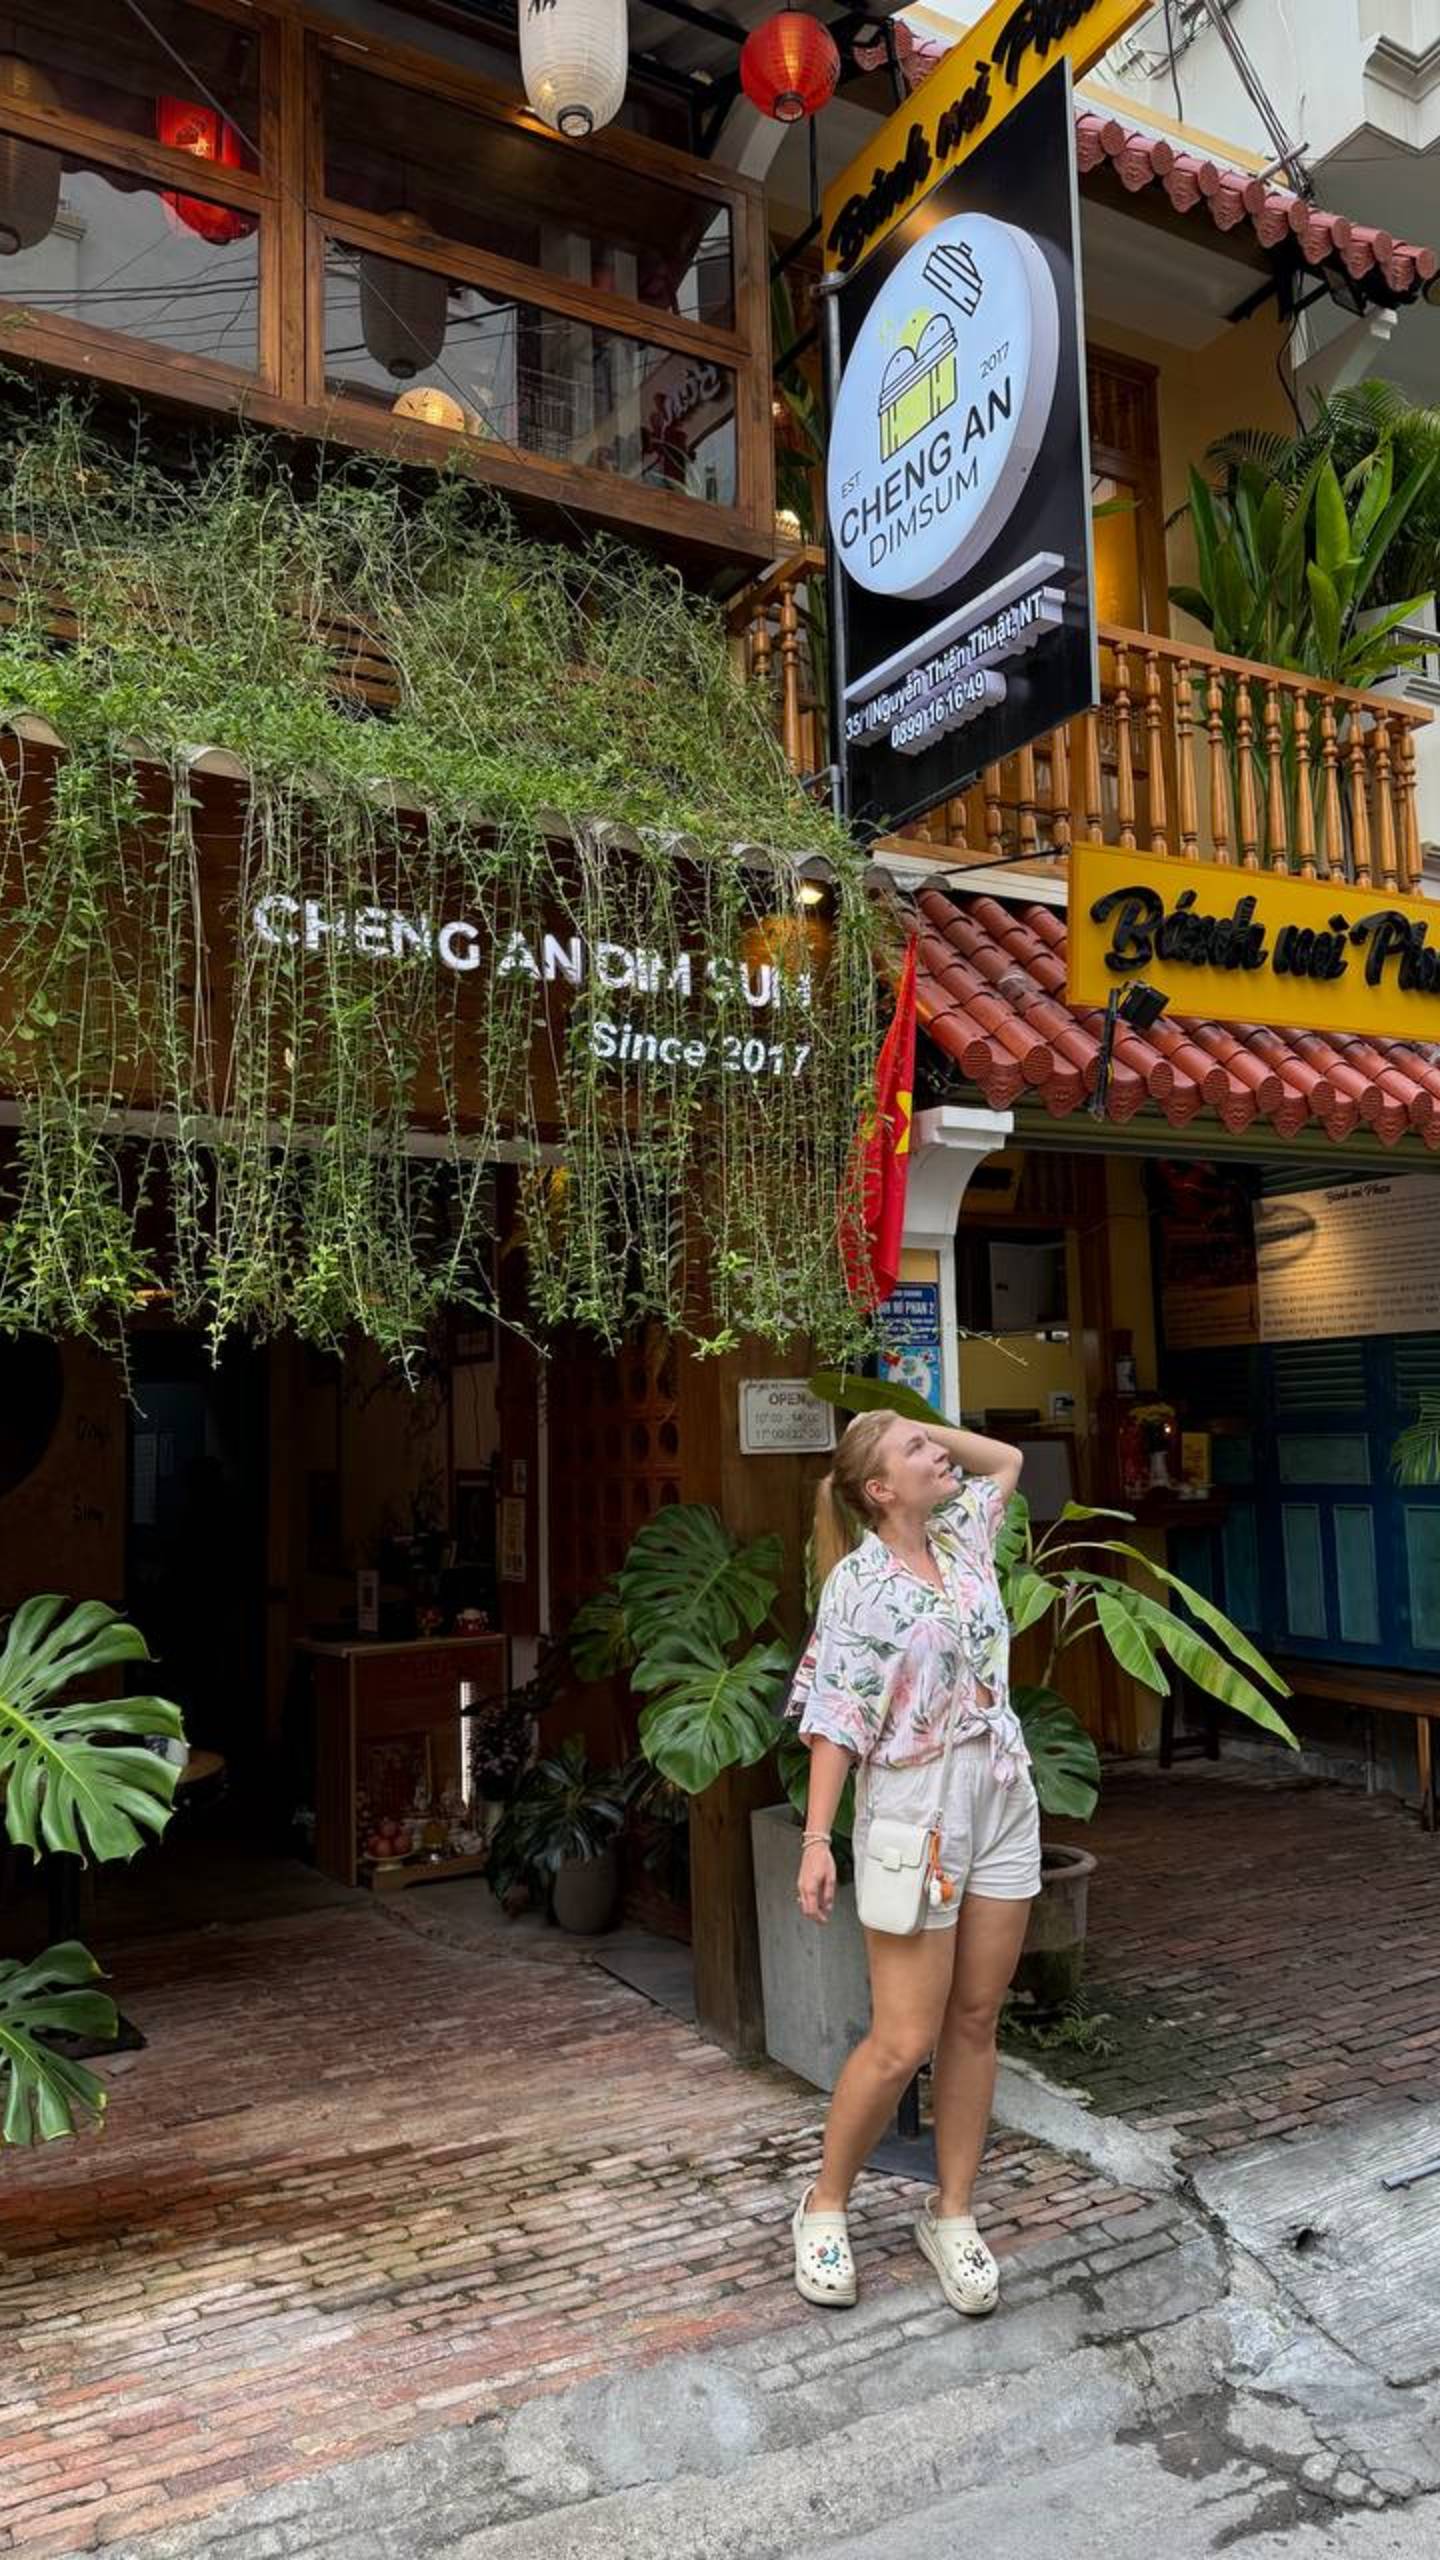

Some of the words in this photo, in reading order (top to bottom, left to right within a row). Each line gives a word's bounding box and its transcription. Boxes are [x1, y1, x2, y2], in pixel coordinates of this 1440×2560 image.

[827, 123, 933, 272] Bánh
[980, 341, 1010, 380] 2017
[841, 430, 951, 549] CHENG
[962, 375, 1012, 454] AN
[841, 470, 863, 498] EST
[869, 456, 979, 569] DIMSUM
[1019, 590, 1043, 627] NT
[891, 711, 924, 748] 0899
[254, 893, 481, 971] CHENG
[497, 930, 582, 986] AN
[596, 941, 692, 997] DIM
[1089, 886, 1268, 972] Bánh
[590, 1021, 707, 1069] Since
[722, 1035, 811, 1077] 2017
